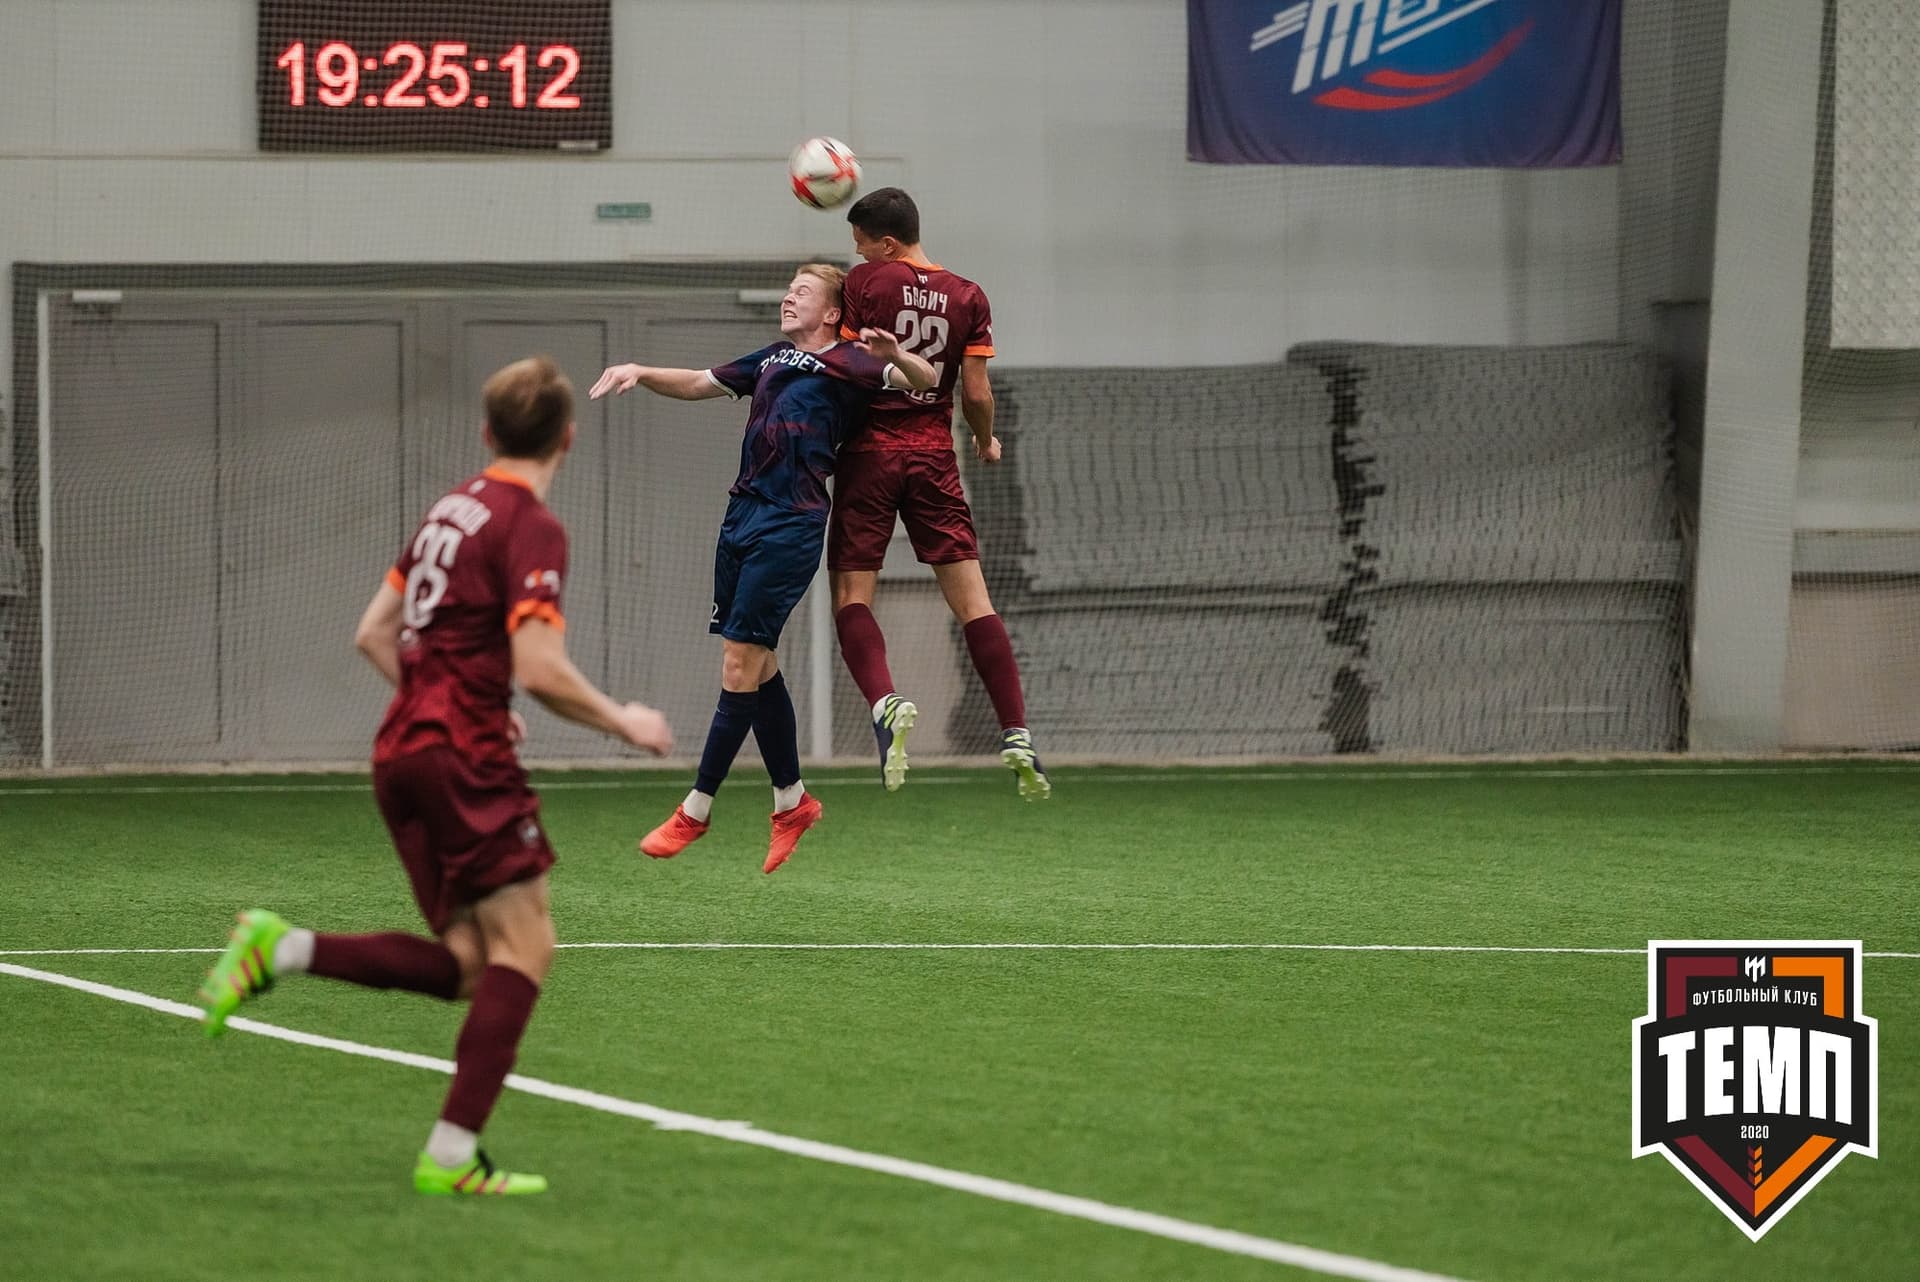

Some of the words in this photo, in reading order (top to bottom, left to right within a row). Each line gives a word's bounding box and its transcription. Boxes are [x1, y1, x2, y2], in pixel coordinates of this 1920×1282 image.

[276, 41, 582, 108] 19:25:12
[902, 285, 949, 314] БАБИЧ
[895, 309, 950, 388] 22
